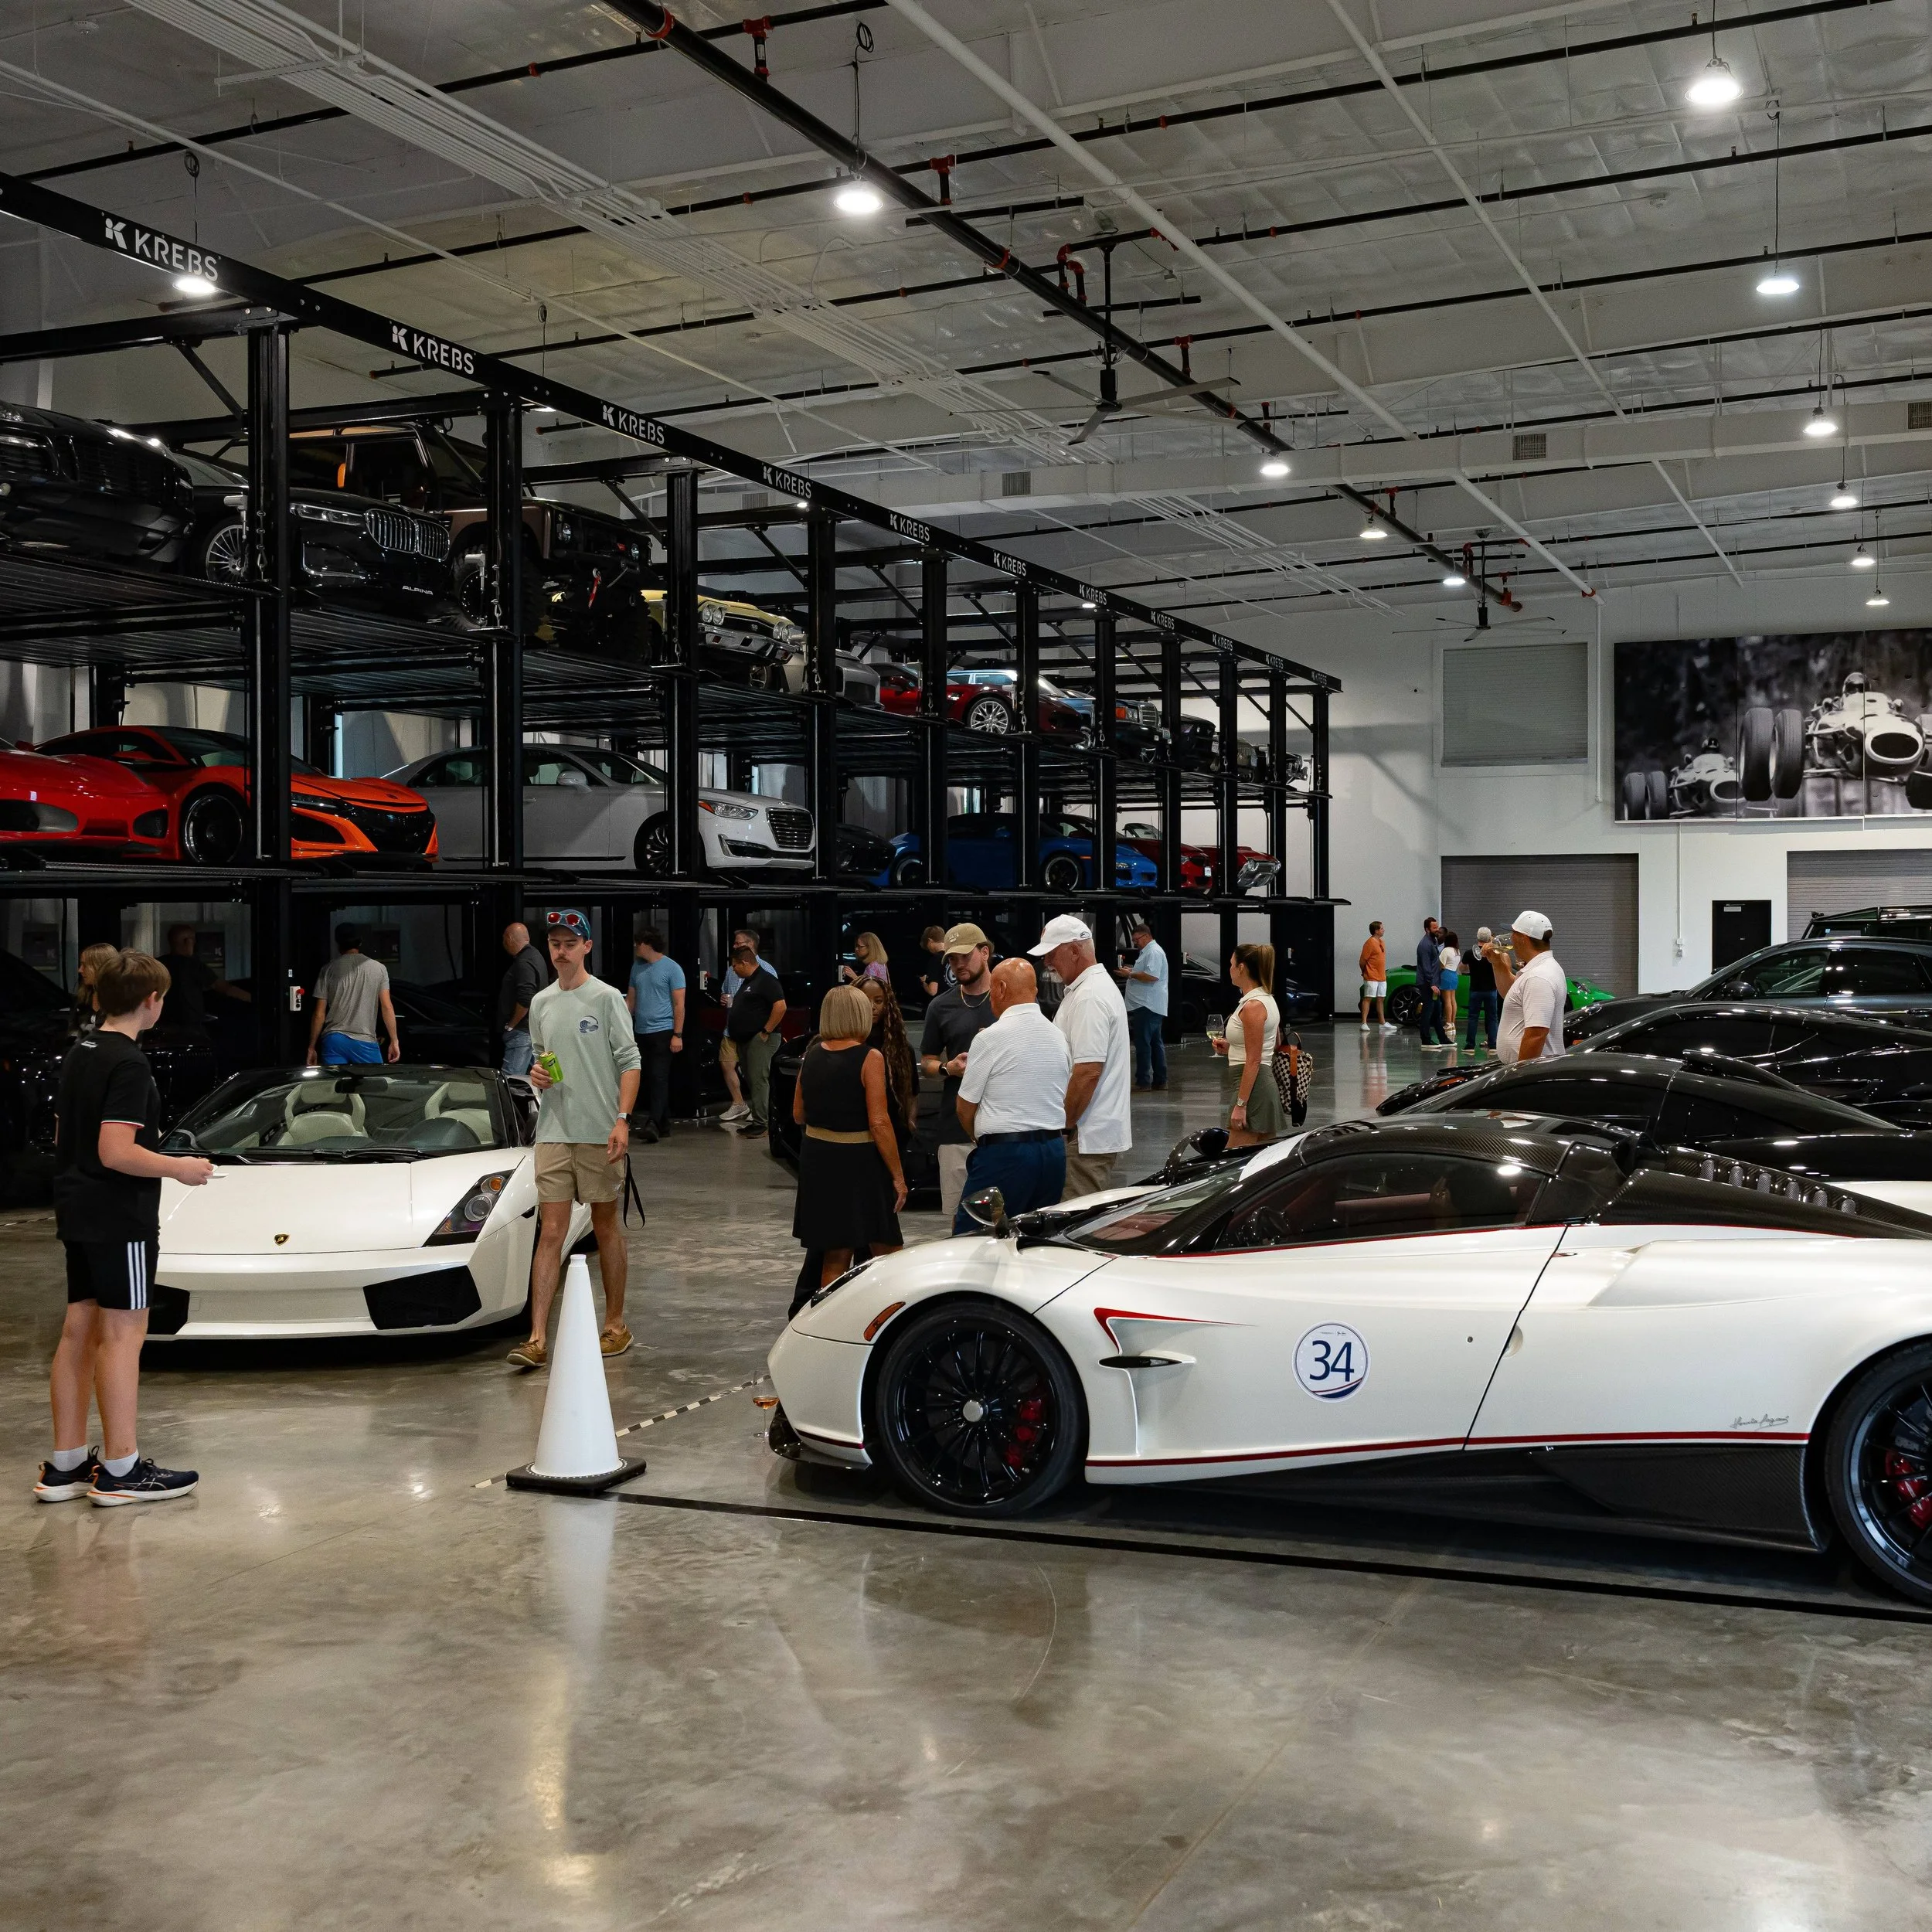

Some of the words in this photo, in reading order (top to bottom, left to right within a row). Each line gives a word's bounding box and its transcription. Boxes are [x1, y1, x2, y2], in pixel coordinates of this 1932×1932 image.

[135, 229, 218, 281] KREBS
[413, 333, 474, 375] KREBS
[619, 410, 665, 444] KREBS
[775, 471, 811, 498] KREBS
[900, 518, 930, 541] KREBS
[1002, 555, 1026, 577] KREBS
[402, 585, 434, 595] ALPINA
[1086, 587, 1107, 605] KREBS
[1157, 613, 1175, 630] KREBS
[1309, 1339, 1355, 1383] 34
